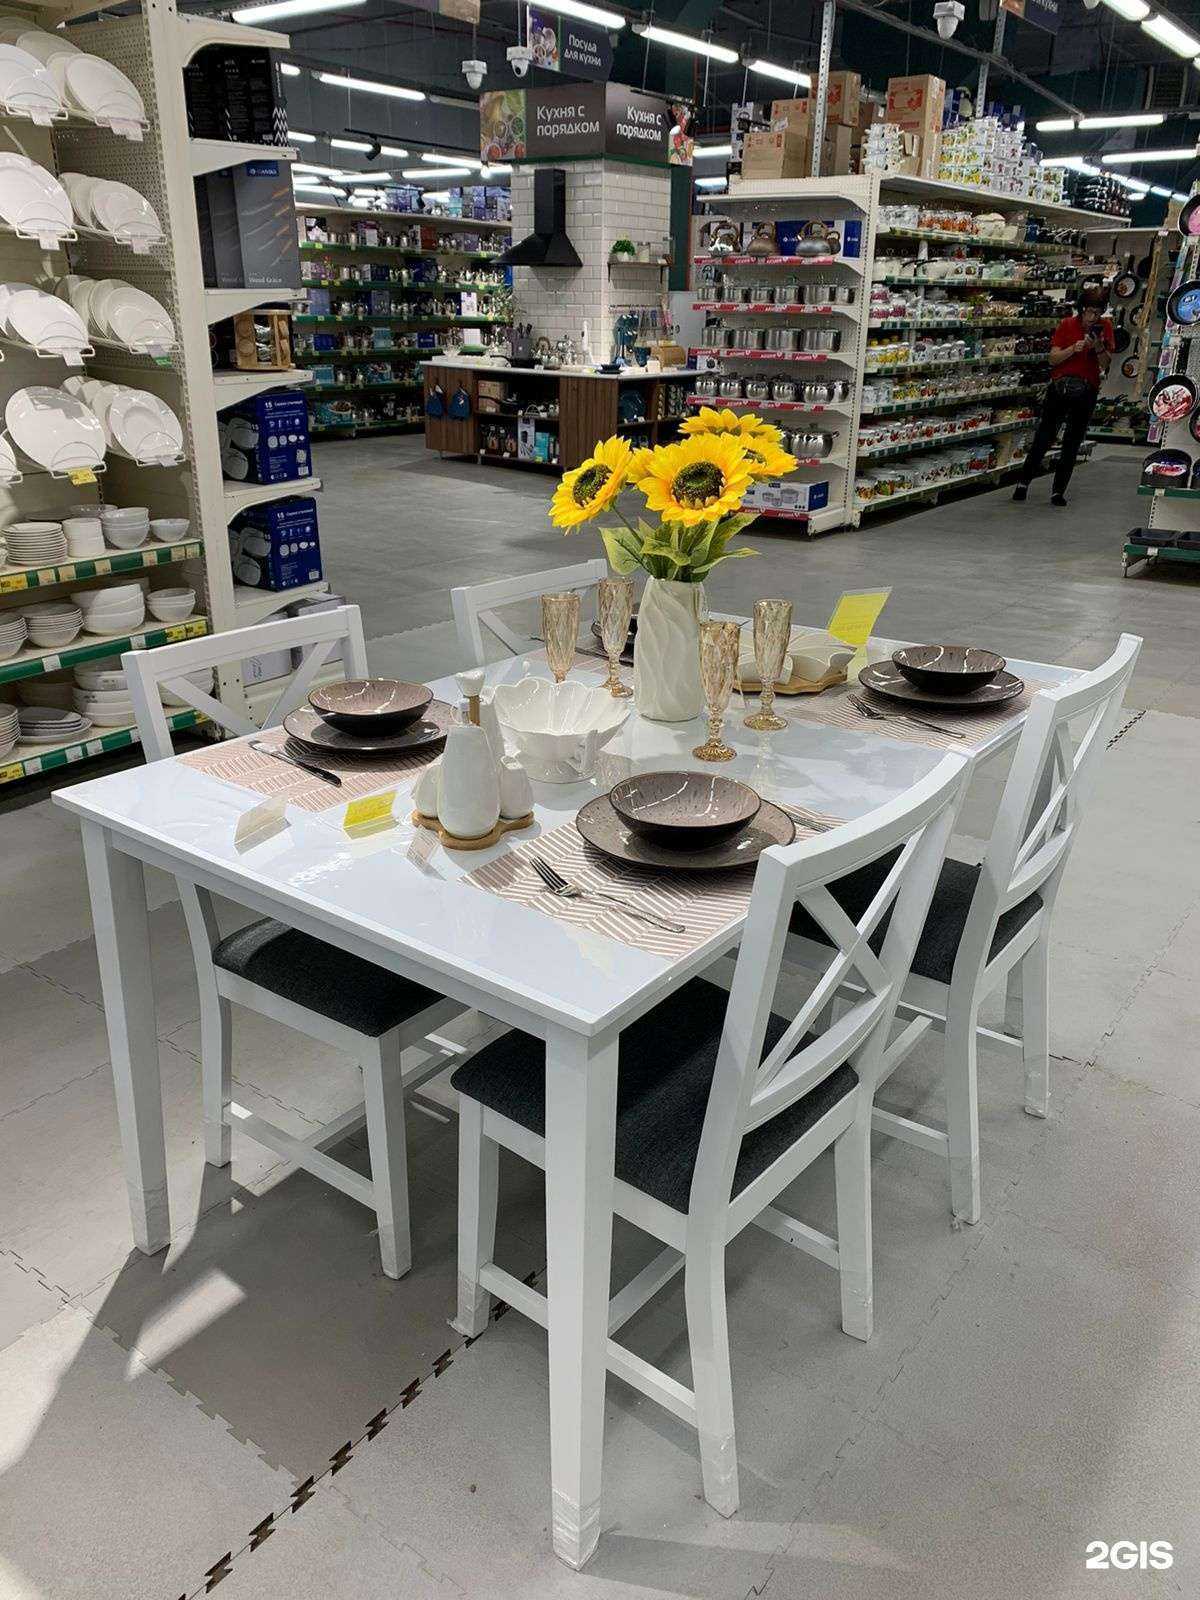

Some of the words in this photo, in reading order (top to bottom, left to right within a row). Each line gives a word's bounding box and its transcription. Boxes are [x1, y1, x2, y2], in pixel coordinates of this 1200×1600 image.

[568, 33, 597, 53] Посуда
[564, 48, 579, 61] для
[579, 52, 601, 67] кухни
[536, 105, 576, 122] Кухня
[577, 105, 585, 117] с
[627, 105, 655, 124] Кухня
[656, 114, 662, 126] с
[536, 120, 600, 139] порядком
[616, 123, 662, 142] порядком
